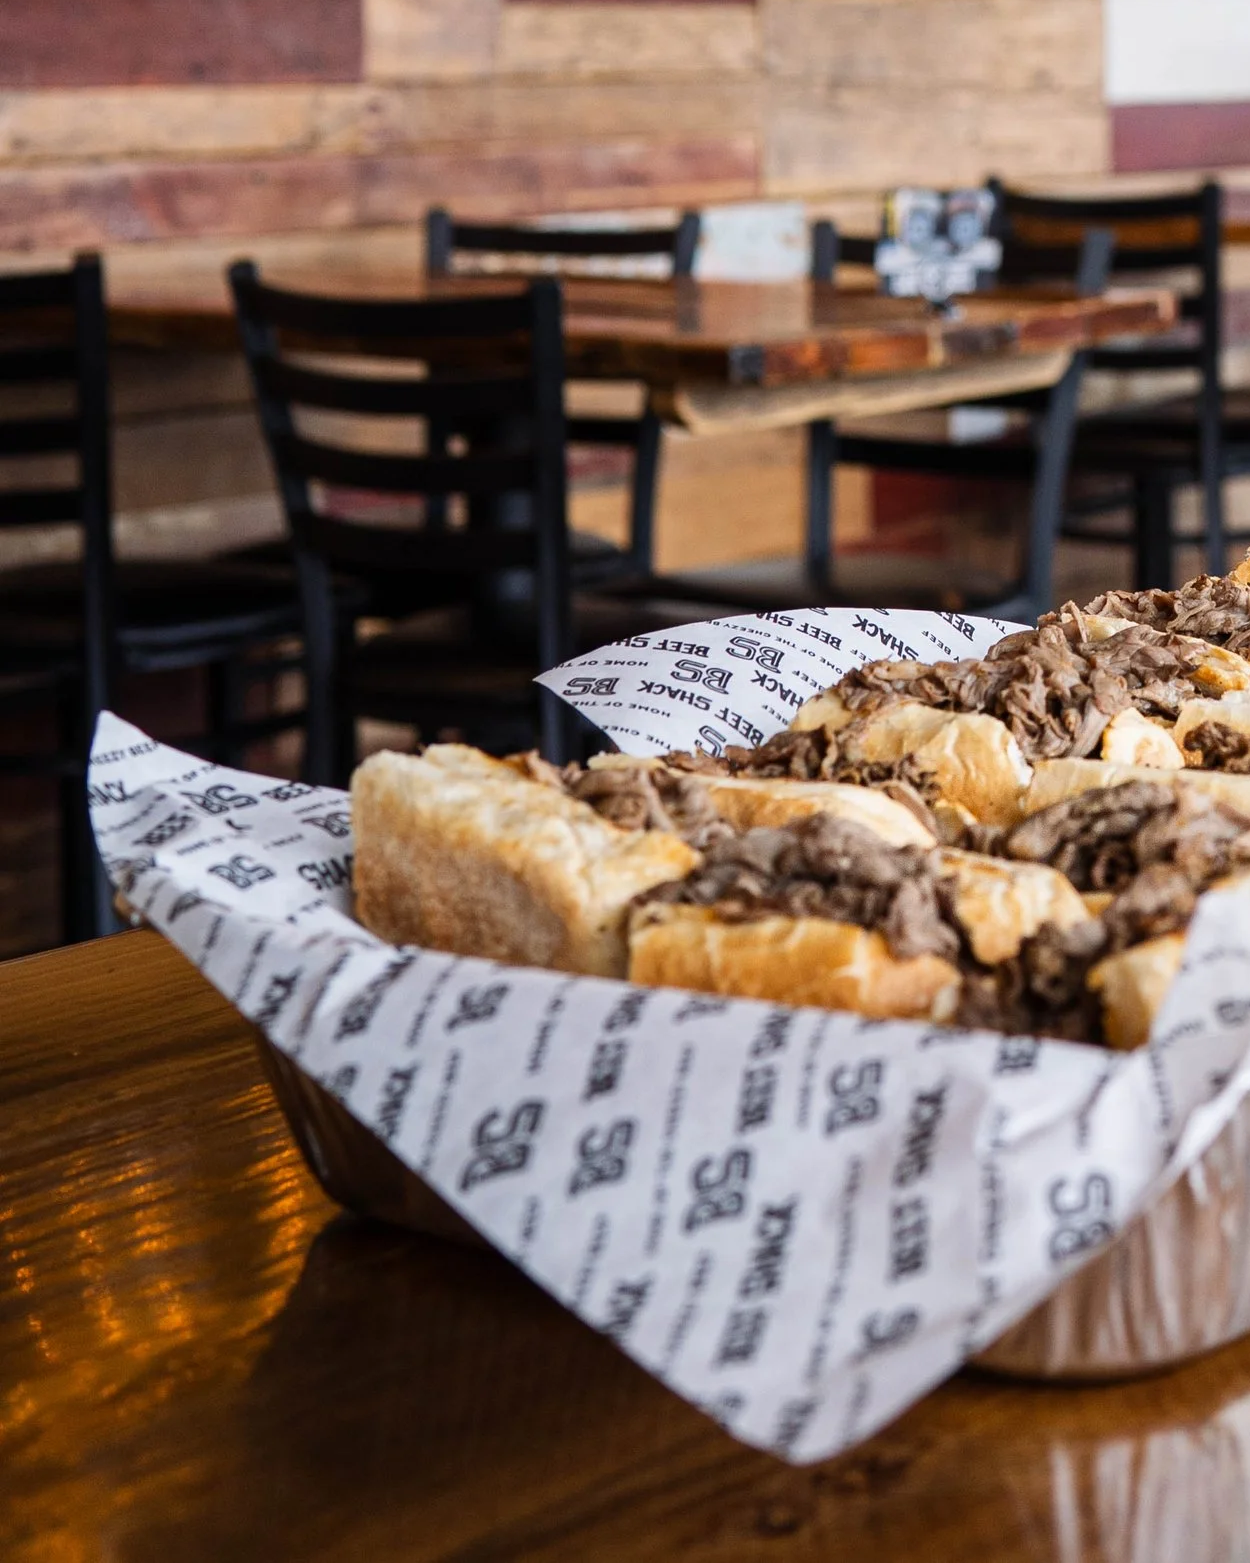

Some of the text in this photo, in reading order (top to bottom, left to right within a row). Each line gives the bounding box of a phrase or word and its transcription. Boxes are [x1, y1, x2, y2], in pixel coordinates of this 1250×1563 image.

[723, 623, 772, 638] CHEEZY
[776, 635, 797, 649] THE
[796, 622, 843, 651] BEEF
[921, 629, 952, 656] BEEF
[652, 639, 711, 659] BEEF
[725, 636, 786, 675] BS
[800, 647, 816, 658] OF
[578, 659, 599, 668] OF
[603, 659, 649, 668] HOME
[818, 656, 851, 679] OME
[562, 677, 621, 697] BS
[670, 658, 734, 696] BS
[750, 669, 805, 710] HACK
[602, 700, 624, 709] OF
[628, 703, 672, 719] HOME
[637, 679, 765, 748] BEEF SHACK
[646, 734, 672, 751] THE
[207, 853, 277, 890] BS
[824, 1058, 885, 1137] BS
[458, 1097, 546, 1195] BS
[566, 1115, 638, 1201] BS
[681, 1146, 752, 1236] BS
